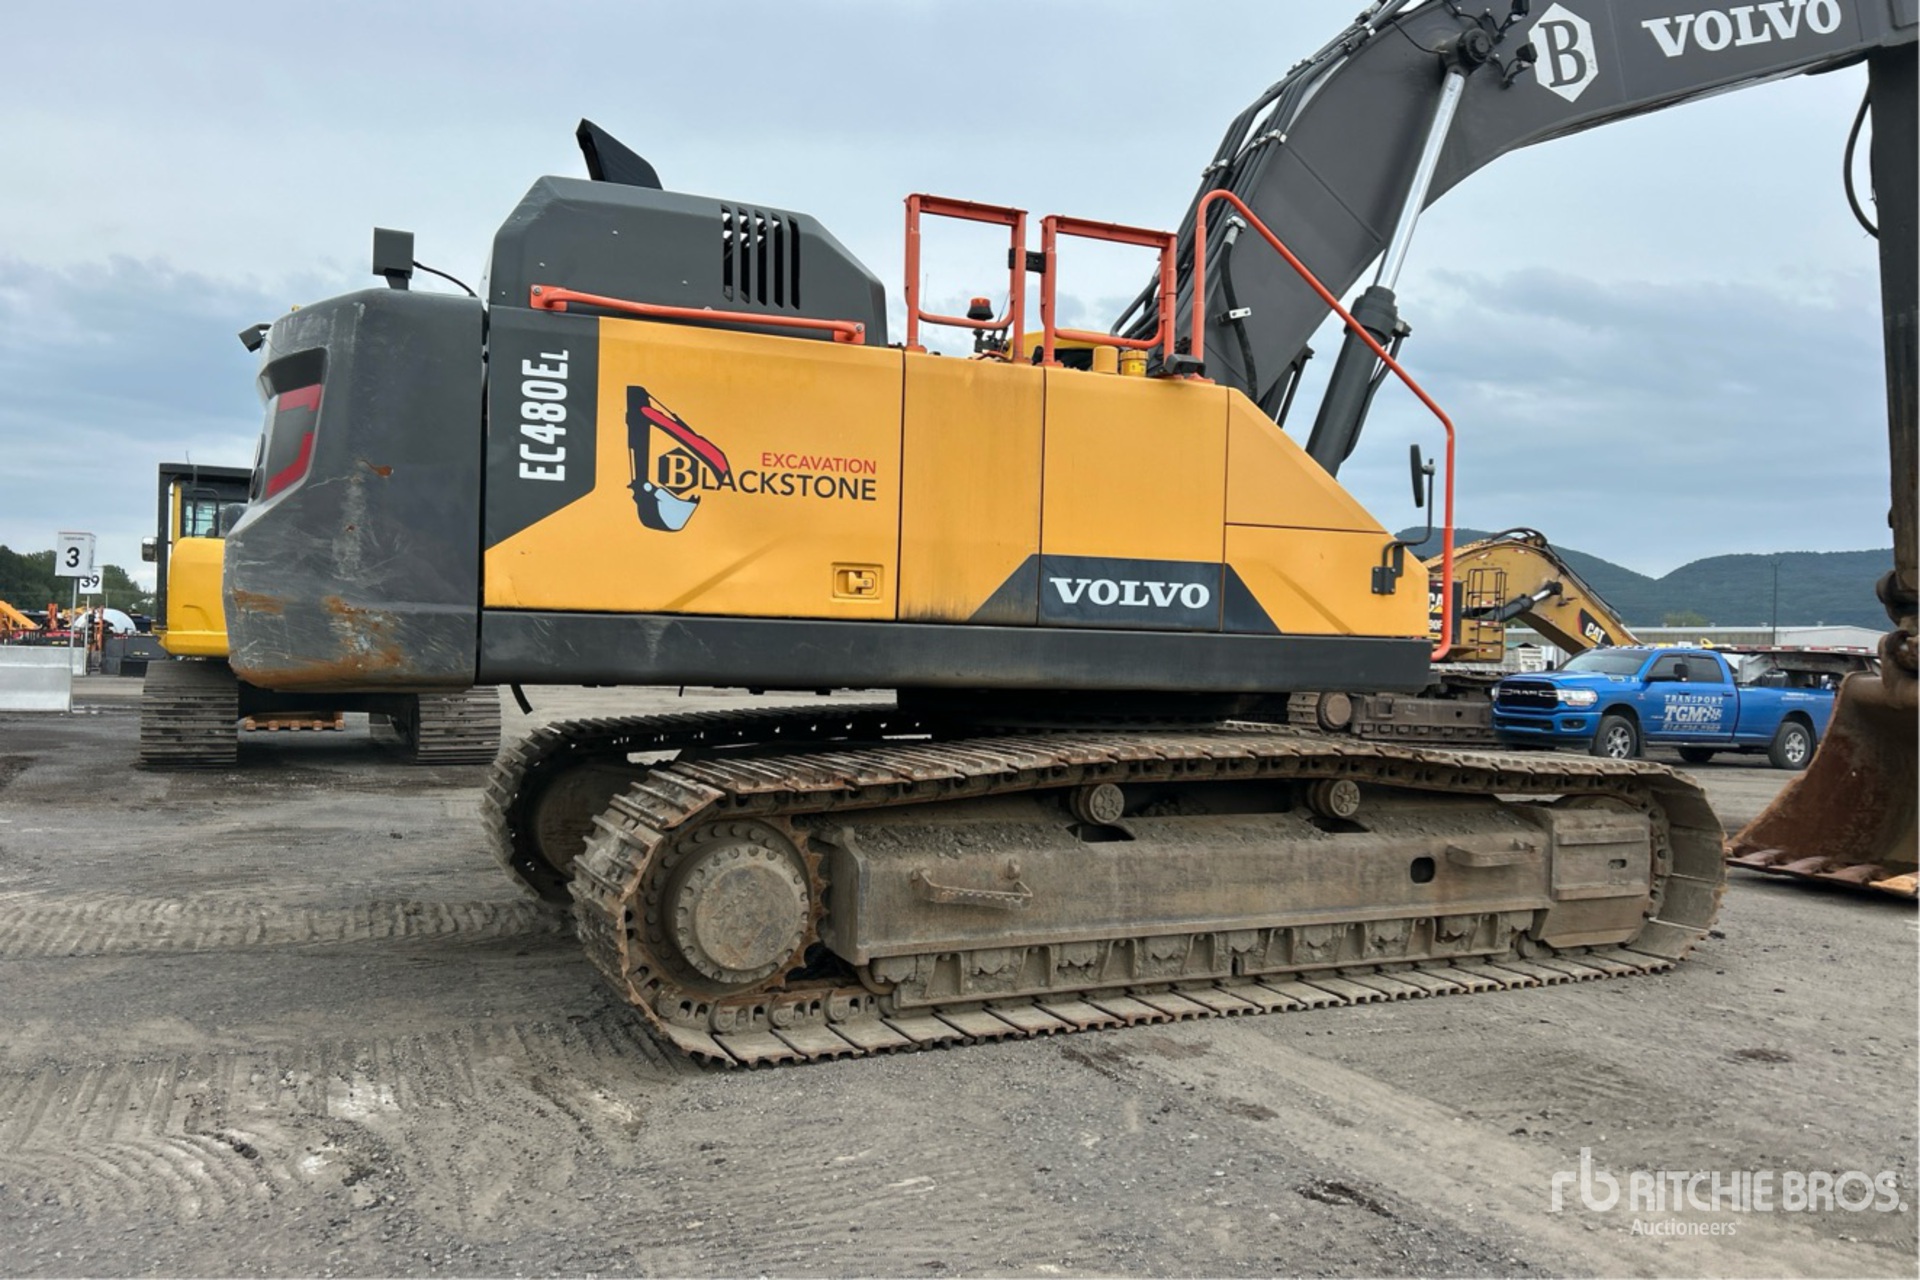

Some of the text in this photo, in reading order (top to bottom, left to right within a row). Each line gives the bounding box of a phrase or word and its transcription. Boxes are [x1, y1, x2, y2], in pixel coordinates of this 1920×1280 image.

[1641, 0, 1842, 58] VOLVO
[1539, 19, 1587, 88] B
[761, 452, 876, 474] EXCAVATION
[66, 547, 80, 568] 3
[81, 575, 100, 588] 39
[1049, 577, 1210, 609] VOLVO
[1585, 622, 1606, 643] CAT
[1664, 694, 1723, 705] TRANSPORT
